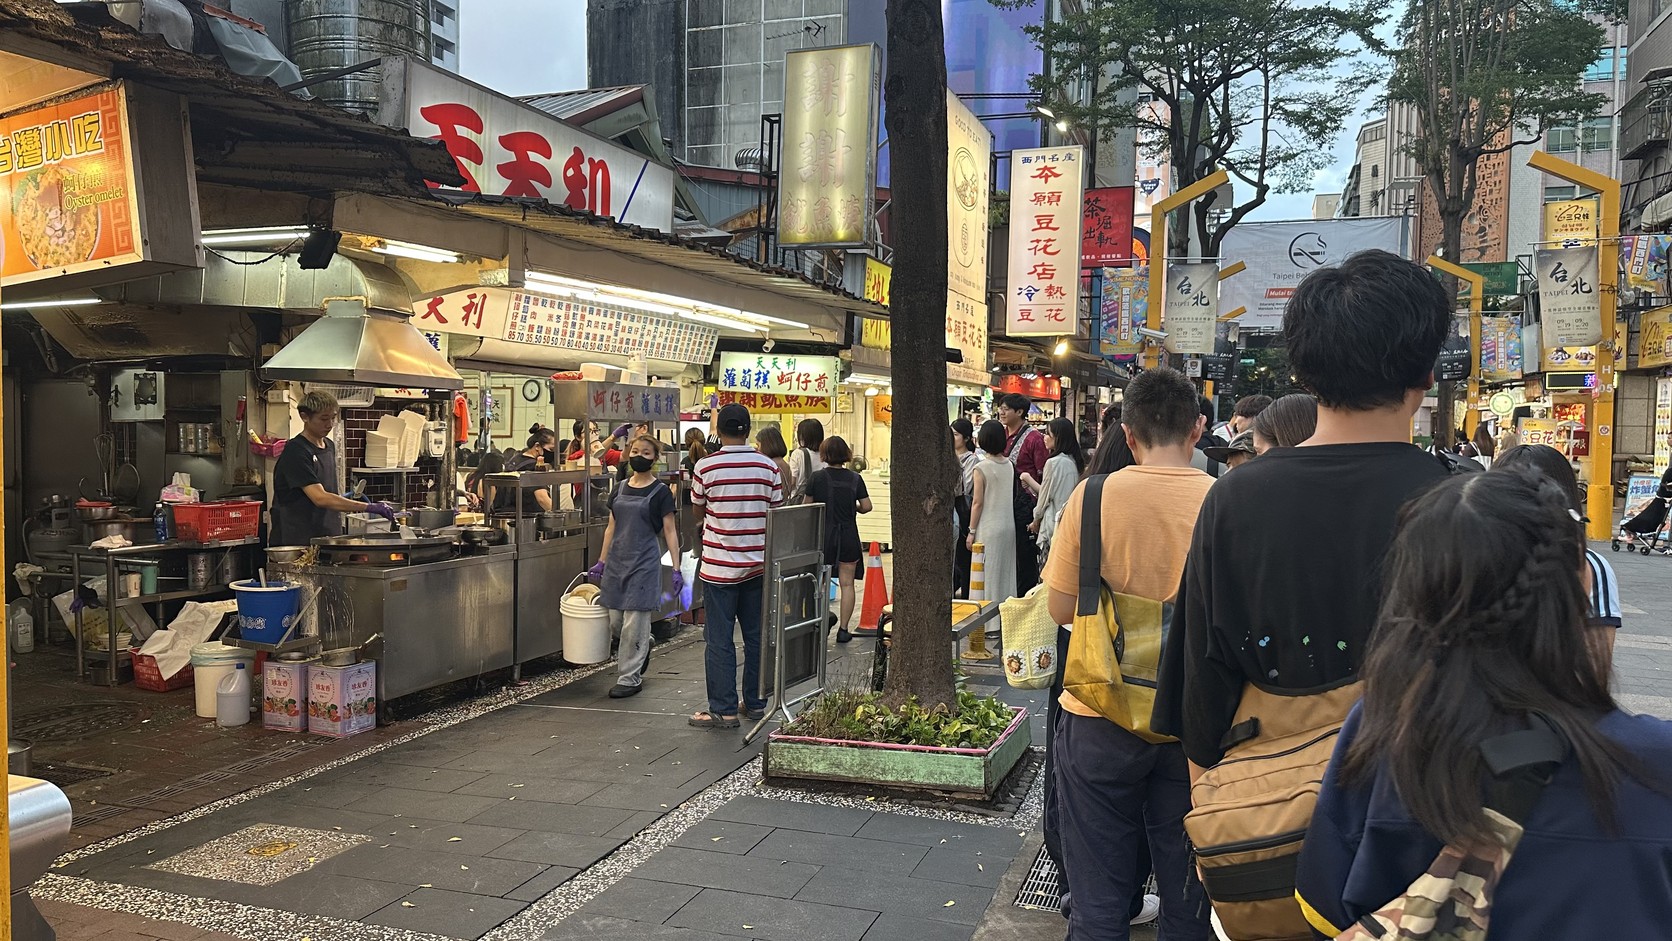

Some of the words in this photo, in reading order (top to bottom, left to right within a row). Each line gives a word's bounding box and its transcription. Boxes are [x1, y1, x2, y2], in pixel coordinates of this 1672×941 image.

[420, 103, 611, 216] 天天利
[1021, 152, 1076, 164] 西門名產
[65, 192, 94, 212] Oyster
[94, 186, 123, 205] omelet
[1028, 165, 1063, 280] 本願豆花店
[1272, 272, 1294, 280] Taipei
[1550, 262, 1592, 295] 台北
[1177, 276, 1210, 307] 台北
[1543, 290, 1568, 298] TAIPEI
[756, 356, 797, 371] 天天利
[1602, 365, 1611, 374] H
[1530, 430, 1553, 445] 豆花
